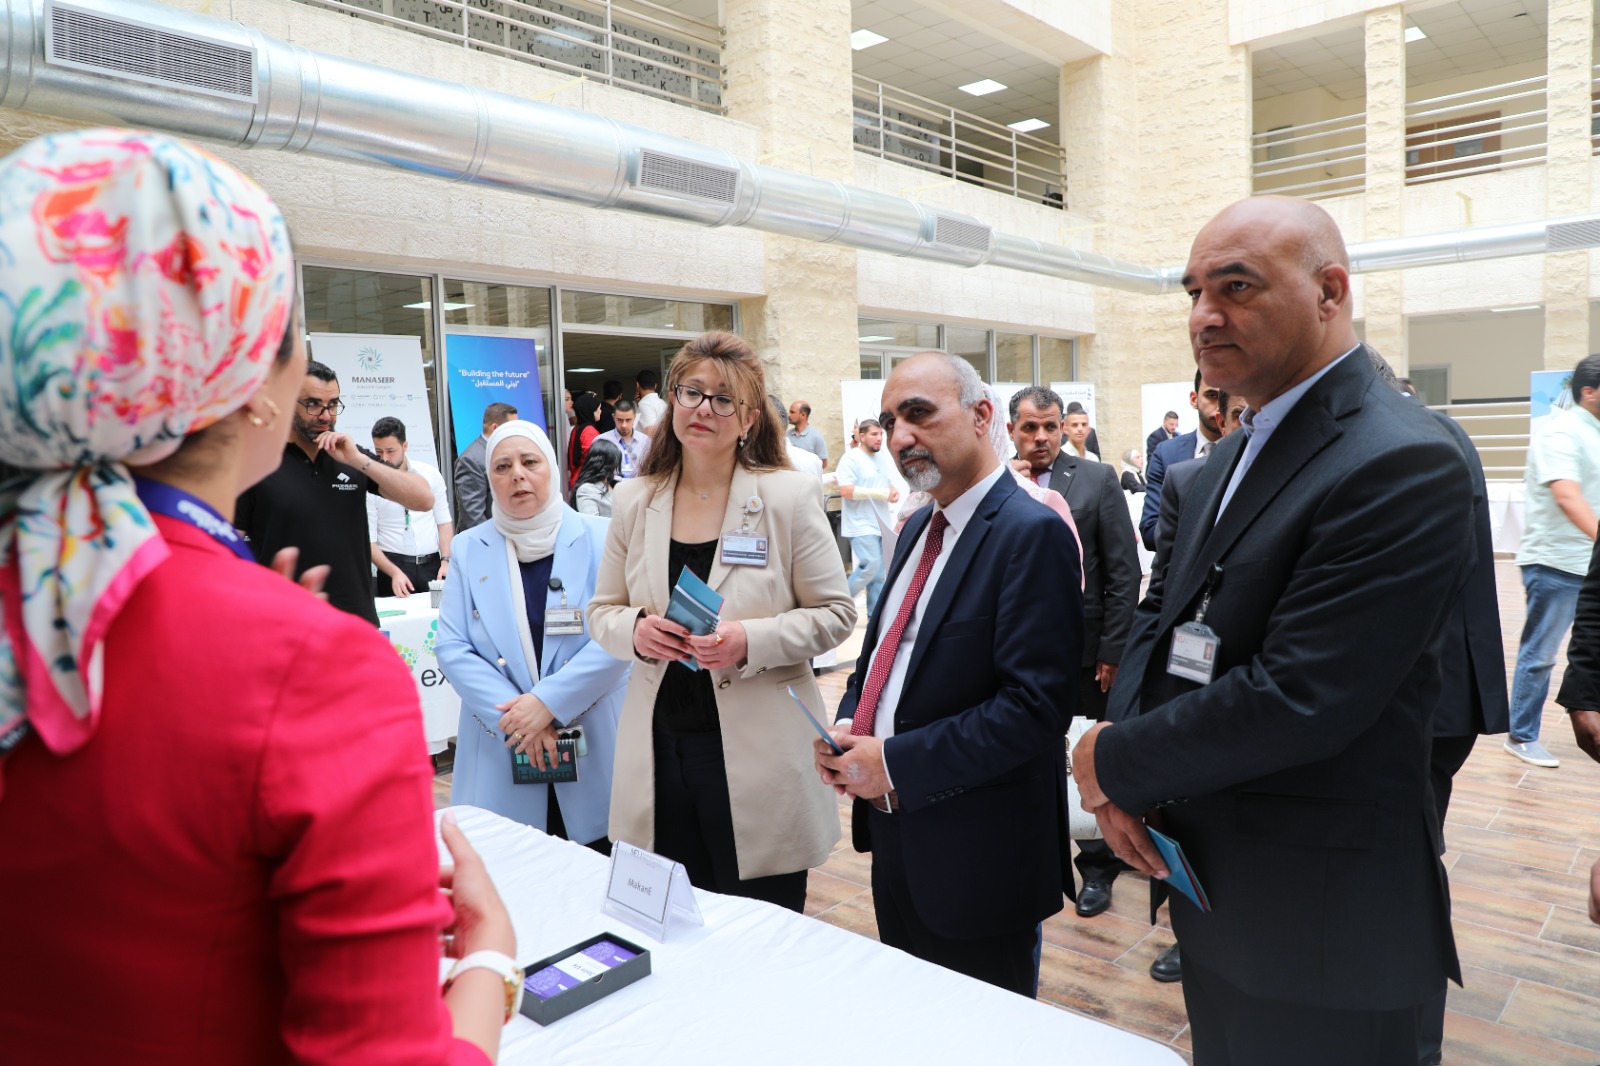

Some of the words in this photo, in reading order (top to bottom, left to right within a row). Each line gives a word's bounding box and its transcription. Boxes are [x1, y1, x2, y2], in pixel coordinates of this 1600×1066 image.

[352, 376, 395, 384] MANASEER
[519, 768, 572, 781] Human
[627, 877, 653, 896] MakanE
